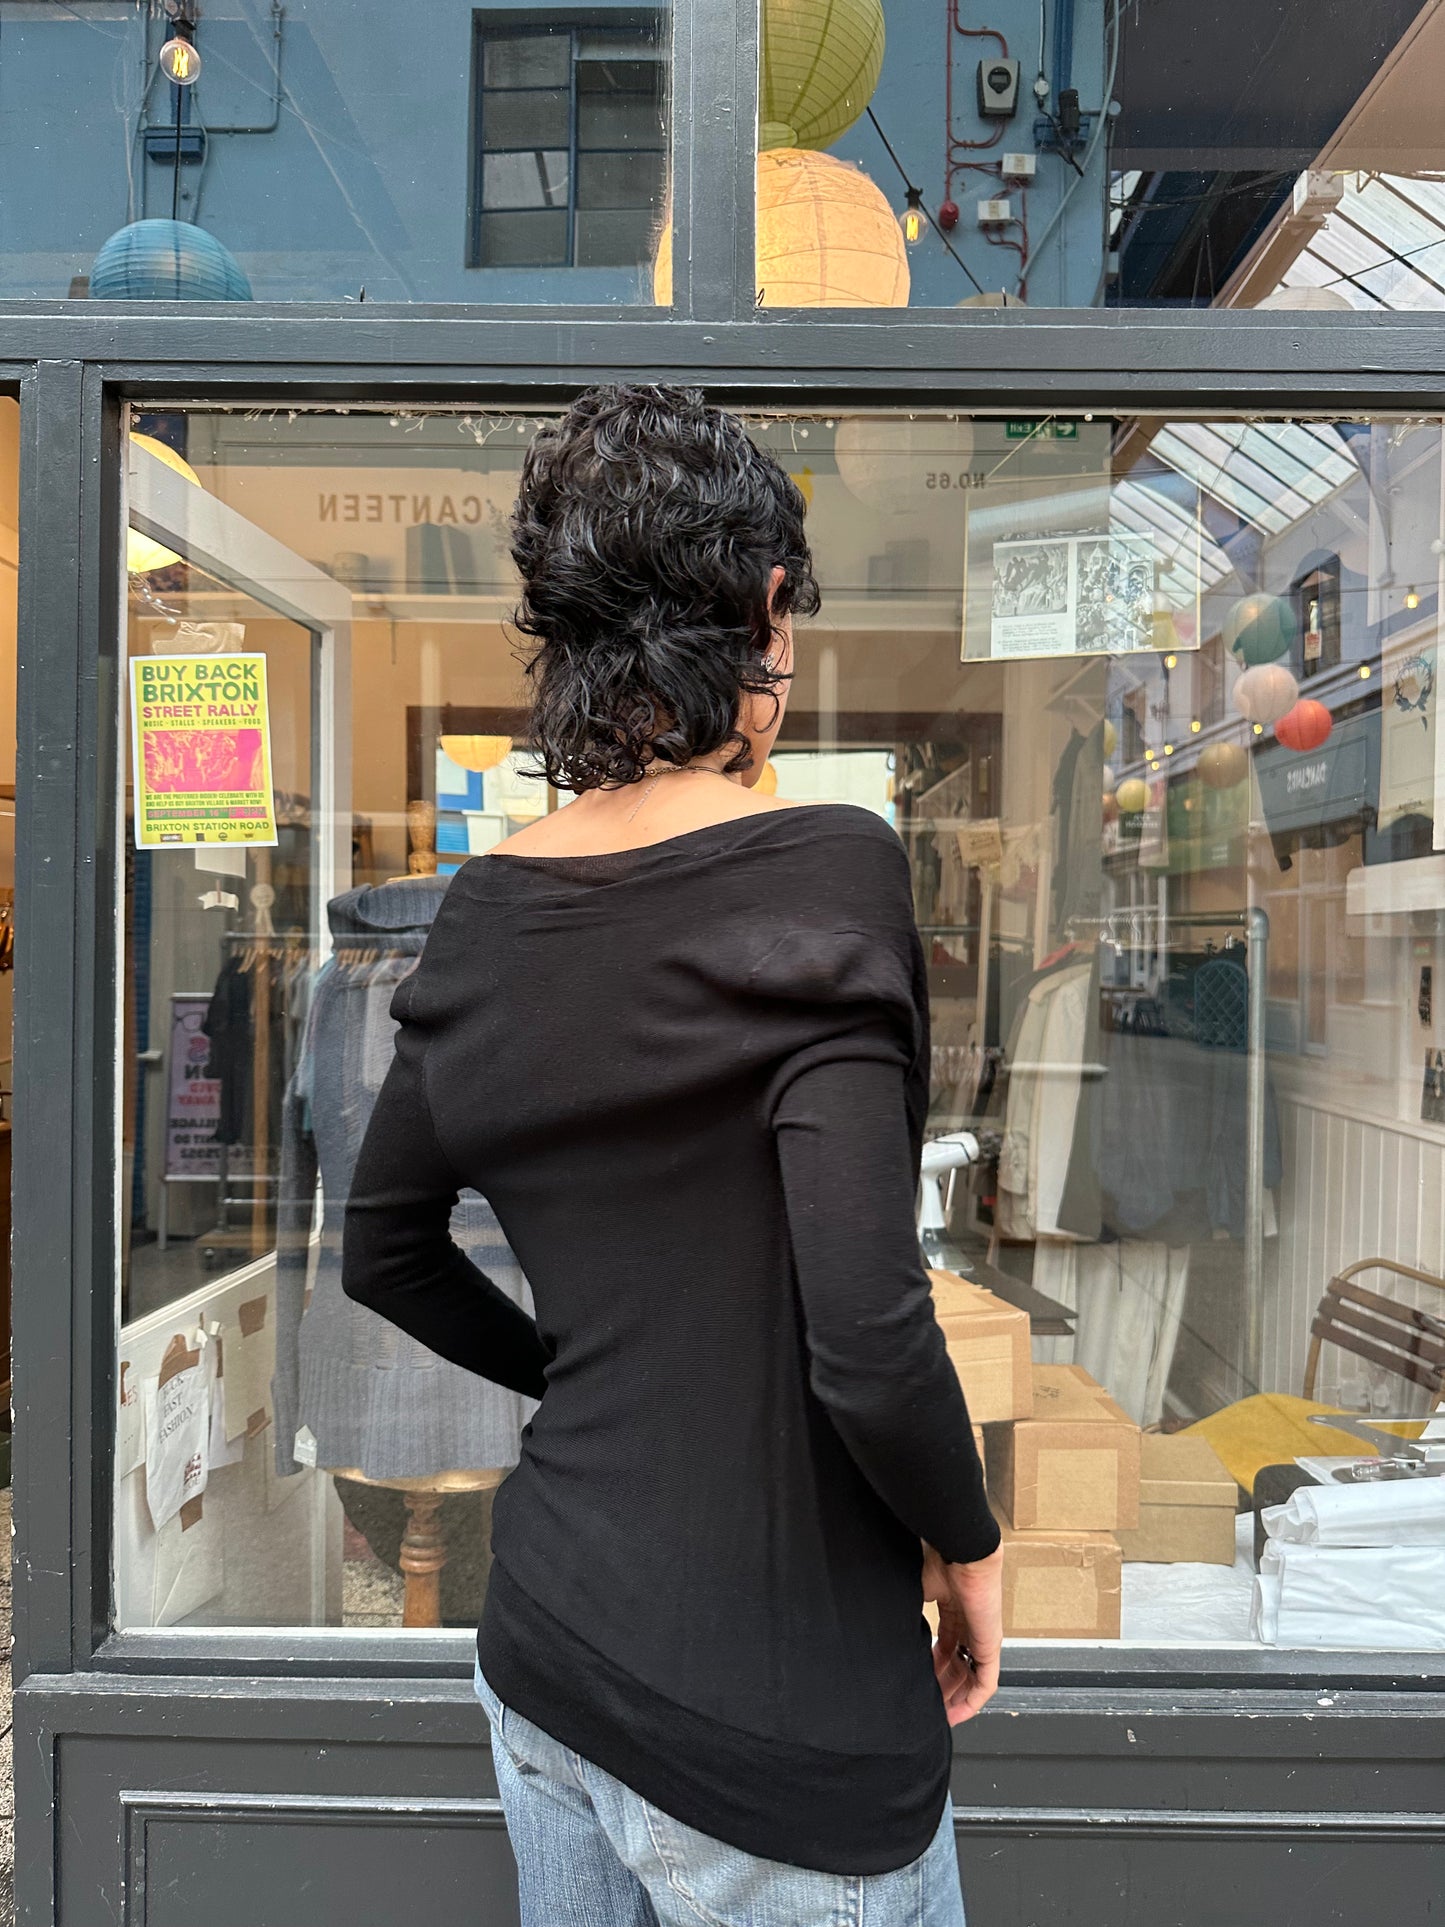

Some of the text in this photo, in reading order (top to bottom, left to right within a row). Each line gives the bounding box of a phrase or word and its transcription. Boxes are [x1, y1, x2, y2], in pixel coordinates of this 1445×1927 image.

[142, 663, 258, 682] BUY BACK
[143, 681, 259, 703] BRIXTON
[143, 704, 258, 719] STREET RALLY
[143, 718, 261, 728] MUSIC STALLS SPEAKERS FOOD
[147, 809, 206, 819] SEPTEMBER
[146, 821, 270, 832] BRIXTON STATION ROAD
[163, 1391, 183, 1418] FAST
[159, 1402, 194, 1444] FASHION
